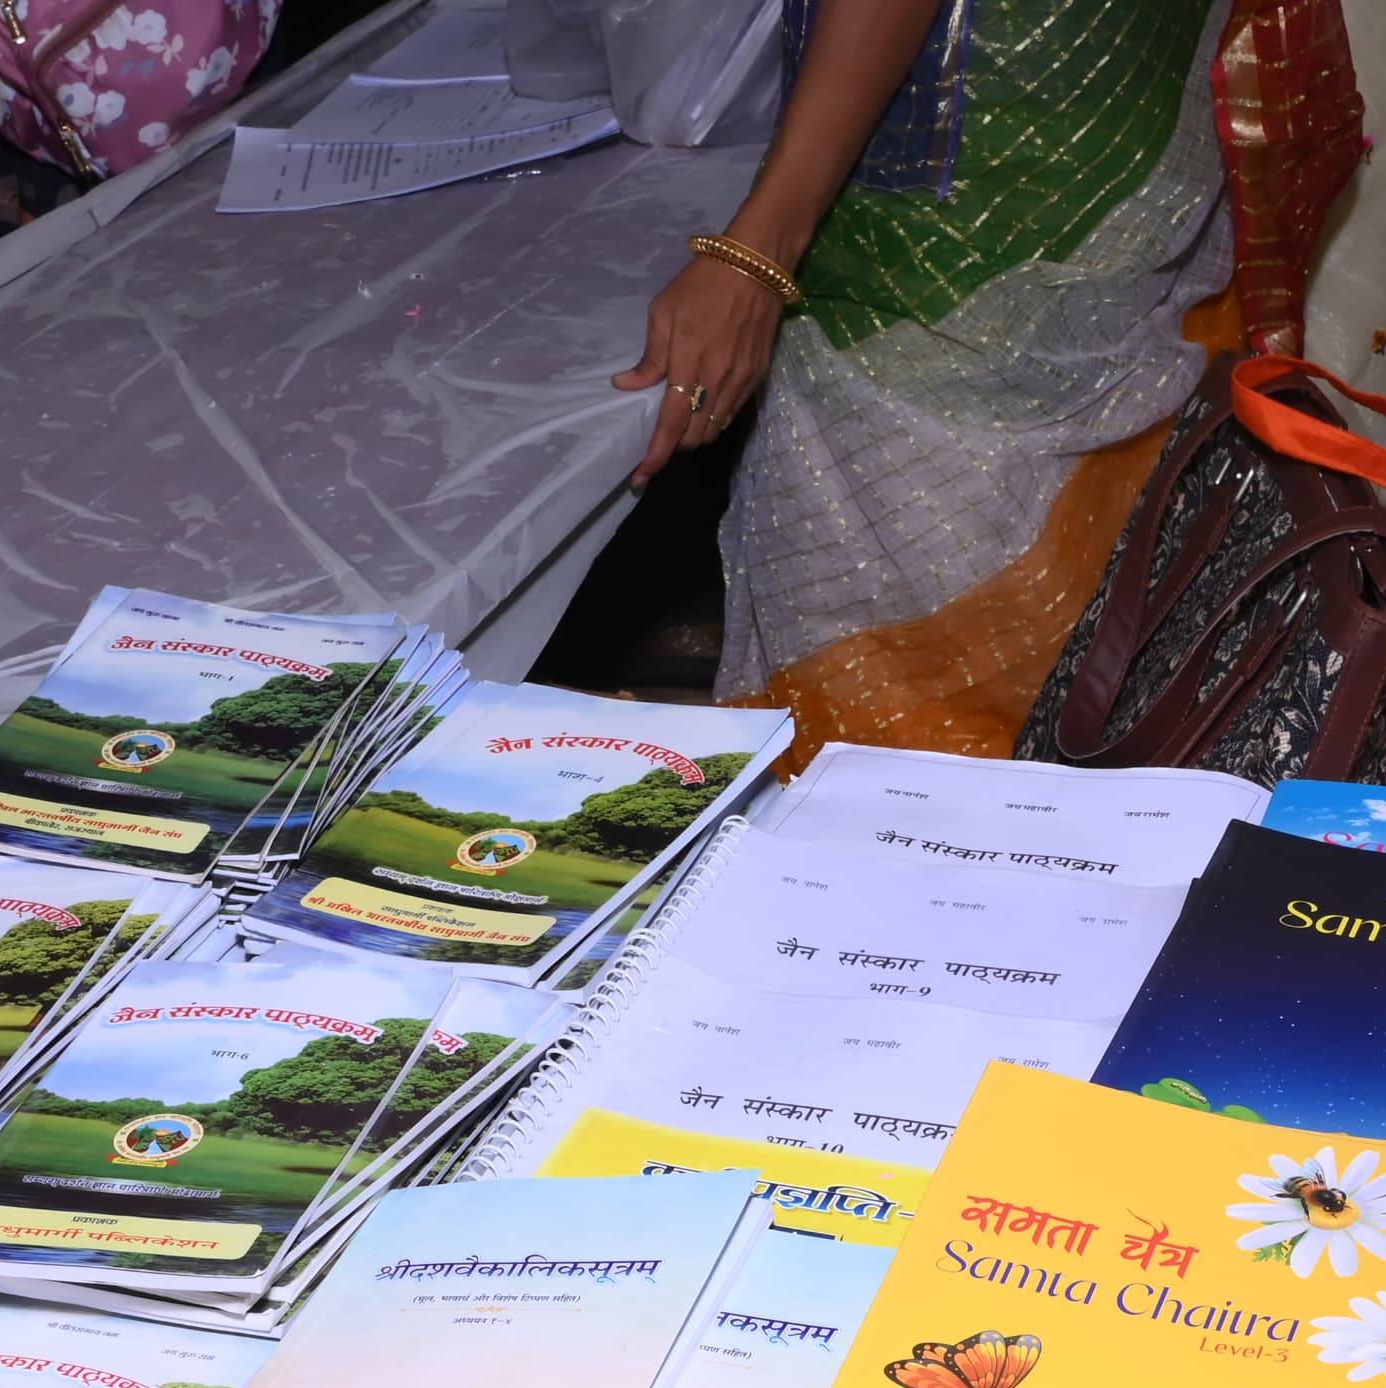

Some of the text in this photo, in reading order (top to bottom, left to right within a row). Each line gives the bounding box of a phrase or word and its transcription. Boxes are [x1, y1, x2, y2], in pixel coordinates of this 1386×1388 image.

[112, 636, 330, 679] जैन संस्कार पाठ्यक्रम
[485, 732, 705, 785] जैन संस्कार पाठ्यक्रम
[876, 830, 1119, 875] जैन संस्कार पाठ्यक्रम
[776, 938, 1061, 986] जैन संस्कार पाठ्यक्रम
[109, 1002, 381, 1042] जैन संस्कार पाठ्यक्रम
[680, 1087, 957, 1141] जैन संस्कार पाठ्यक्र
[71, 1216, 118, 1225] प्रकाशक
[87, 1230, 220, 1250] पब्लिकेशन
[961, 1194, 1200, 1280] समता चैत्र
[375, 1254, 662, 1284] श्रीदशवैकालिकसूत्रम्
[935, 1239, 1299, 1342] Samta Chaitra
[1199, 1337, 1289, 1363] Level-3
